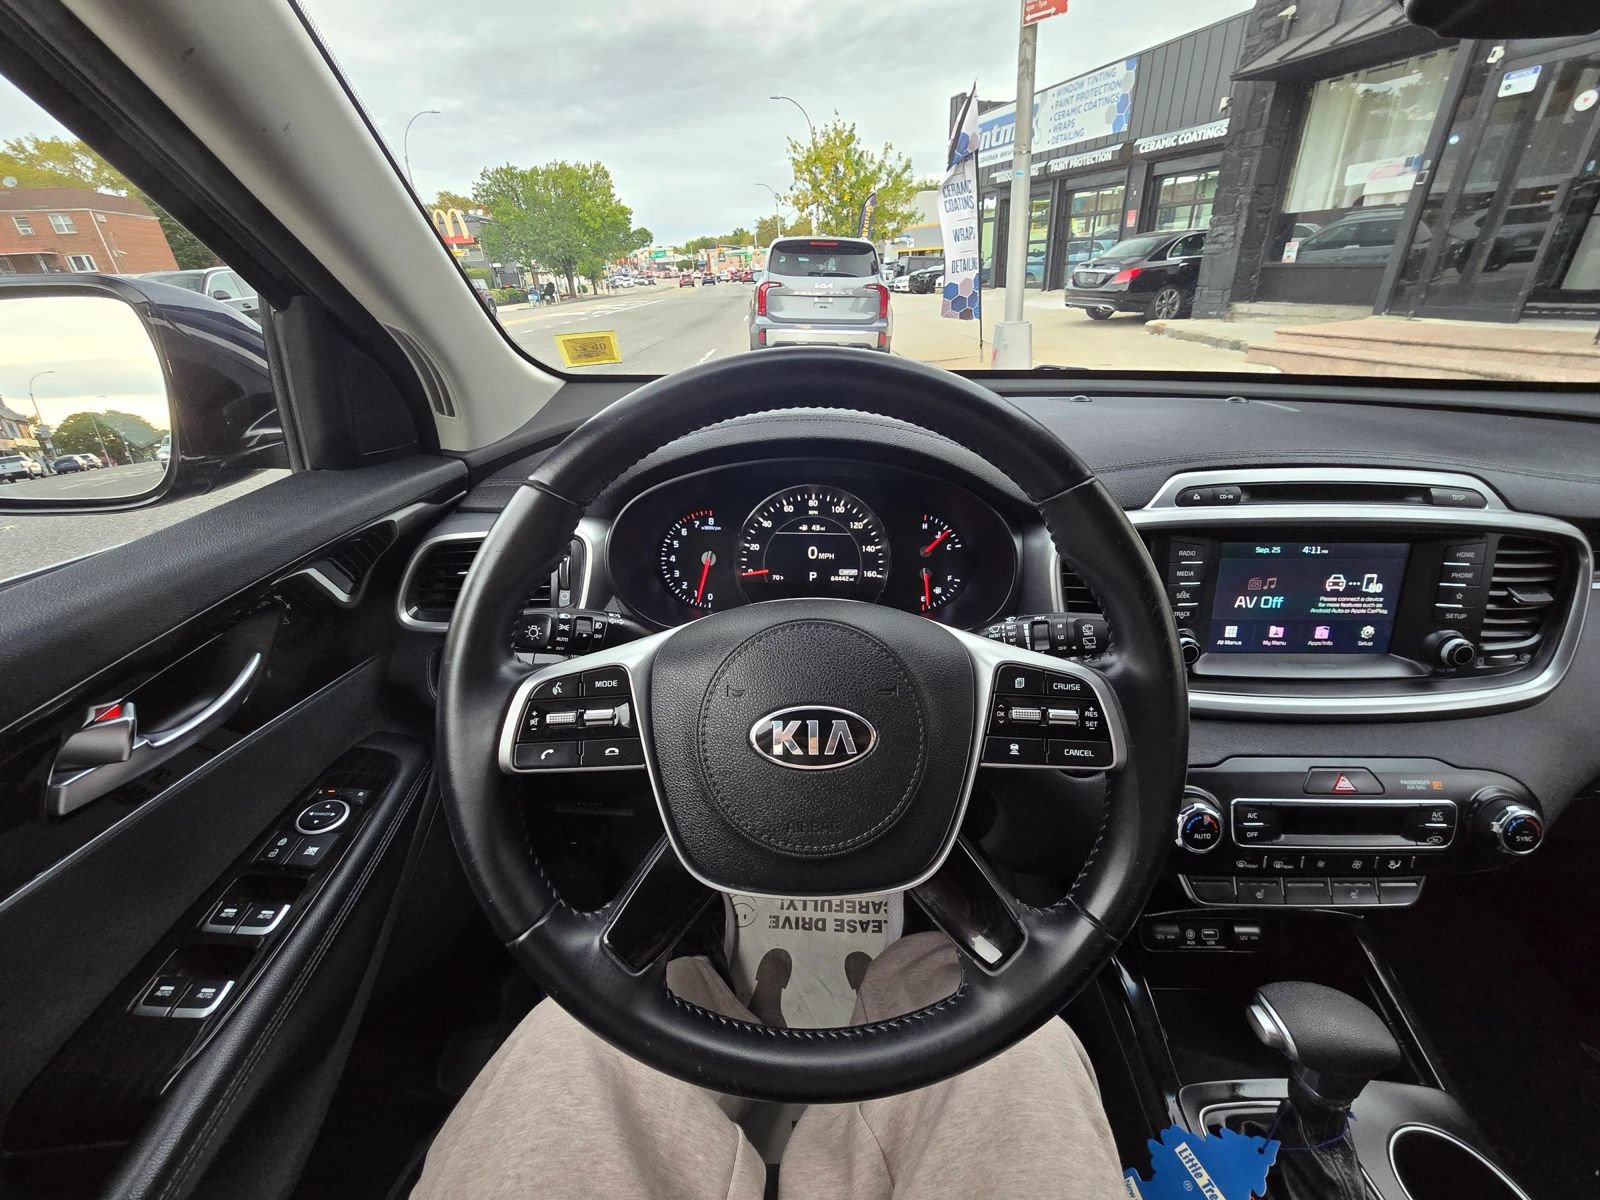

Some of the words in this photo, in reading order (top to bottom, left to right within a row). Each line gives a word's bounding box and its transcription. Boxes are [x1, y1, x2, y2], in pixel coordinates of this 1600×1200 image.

[1056, 80, 1085, 97] WINDOW
[1087, 67, 1117, 84] TINTING
[1055, 95, 1074, 109] PAINT
[1075, 80, 1121, 103] PROTECTION
[1053, 105, 1082, 122] CERAMIC
[1083, 93, 1120, 112] COATINGS
[1053, 118, 1076, 133] WRAPS
[1051, 128, 1085, 145] DETAILING
[1139, 135, 1178, 153] CERAMIC
[1179, 124, 1228, 146] COATINGS
[1050, 159, 1069, 173] PAINT
[1069, 151, 1112, 168] PROTECTION
[783, 505, 794, 513] 60
[831, 505, 845, 514] 100
[694, 520, 700, 529] 7
[708, 517, 715, 525] 8
[761, 520, 772, 528] 40
[849, 521, 863, 529] 120
[681, 528, 687, 536] 6
[673, 540, 679, 548] 5
[750, 543, 760, 551] 20
[808, 546, 818, 560] 0
[862, 545, 876, 553] 140
[1271, 546, 1281, 554] 25
[809, 572, 817, 581] P
[863, 570, 877, 578] 160
[682, 581, 688, 589] 2
[1234, 596, 1257, 609] AV
[1260, 596, 1284, 609] Off
[594, 680, 618, 688] MODE
[1053, 683, 1081, 691] CRUISE
[771, 719, 858, 756] KIA
[1064, 749, 1094, 757] CANCEL
[769, 915, 827, 933] DRIVE
[833, 918, 888, 934] EASE
[1178, 1147, 1203, 1179] Little
[1201, 1178, 1219, 1200] Tre
[1124, 1179, 1137, 1200] New
